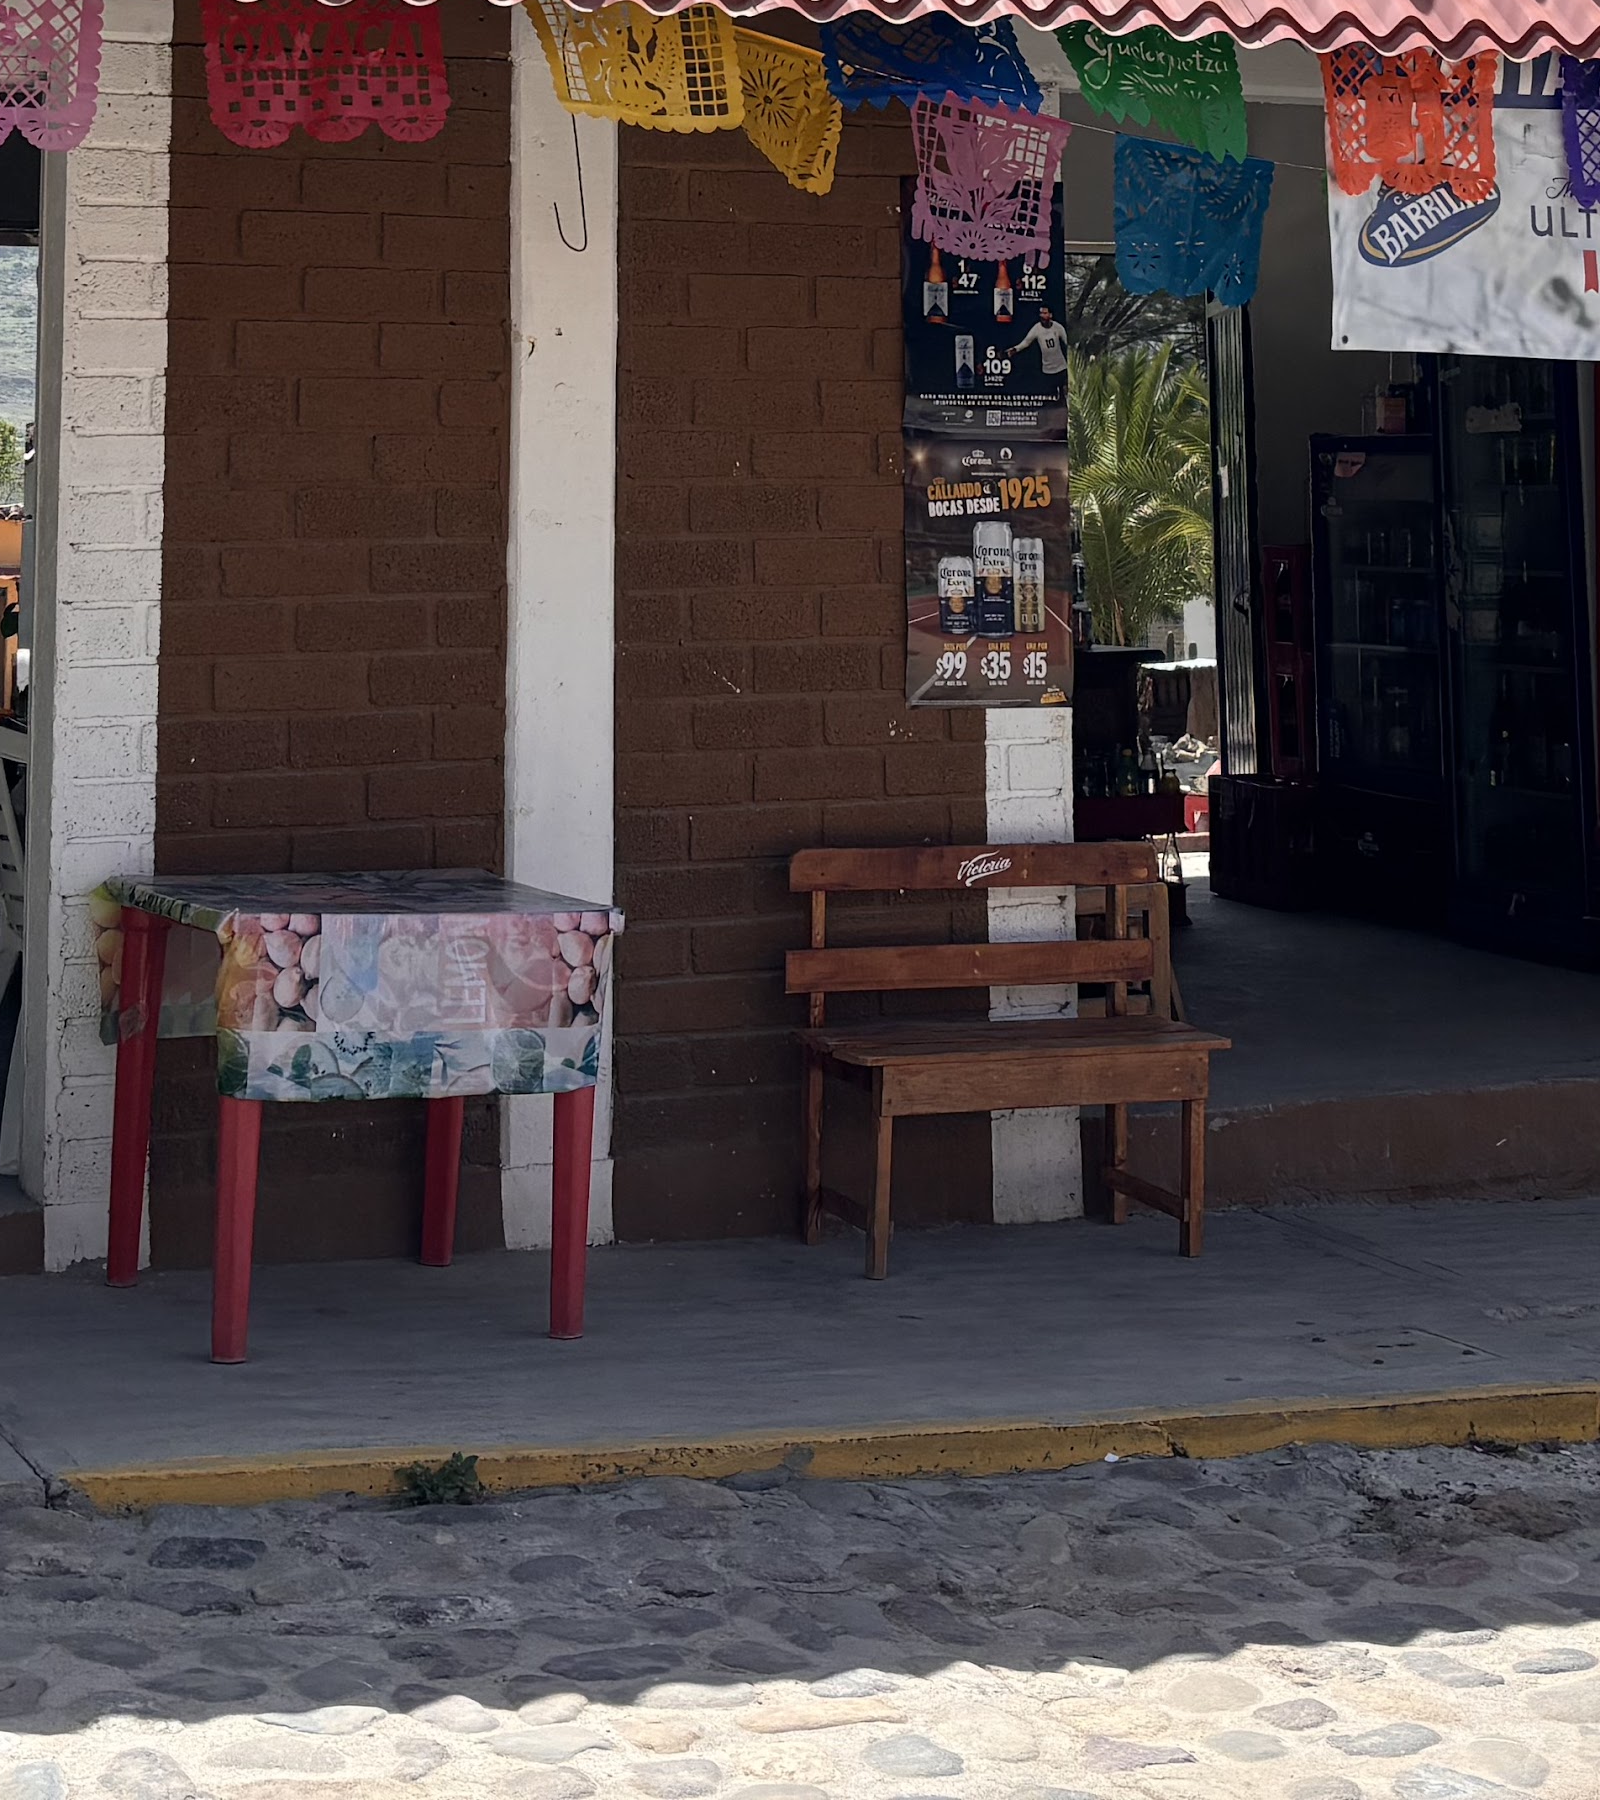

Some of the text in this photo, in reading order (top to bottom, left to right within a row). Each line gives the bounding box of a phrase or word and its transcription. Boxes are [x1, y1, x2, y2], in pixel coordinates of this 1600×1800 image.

[927, 481, 982, 501] CALLANDO
[998, 475, 1052, 510] 1925
[928, 496, 1001, 518] BOCAS DESDE
[936, 651, 967, 680] $99
[980, 651, 1011, 680] $35
[1023, 651, 1048, 679] $15
[957, 850, 1013, 887] Victoria
